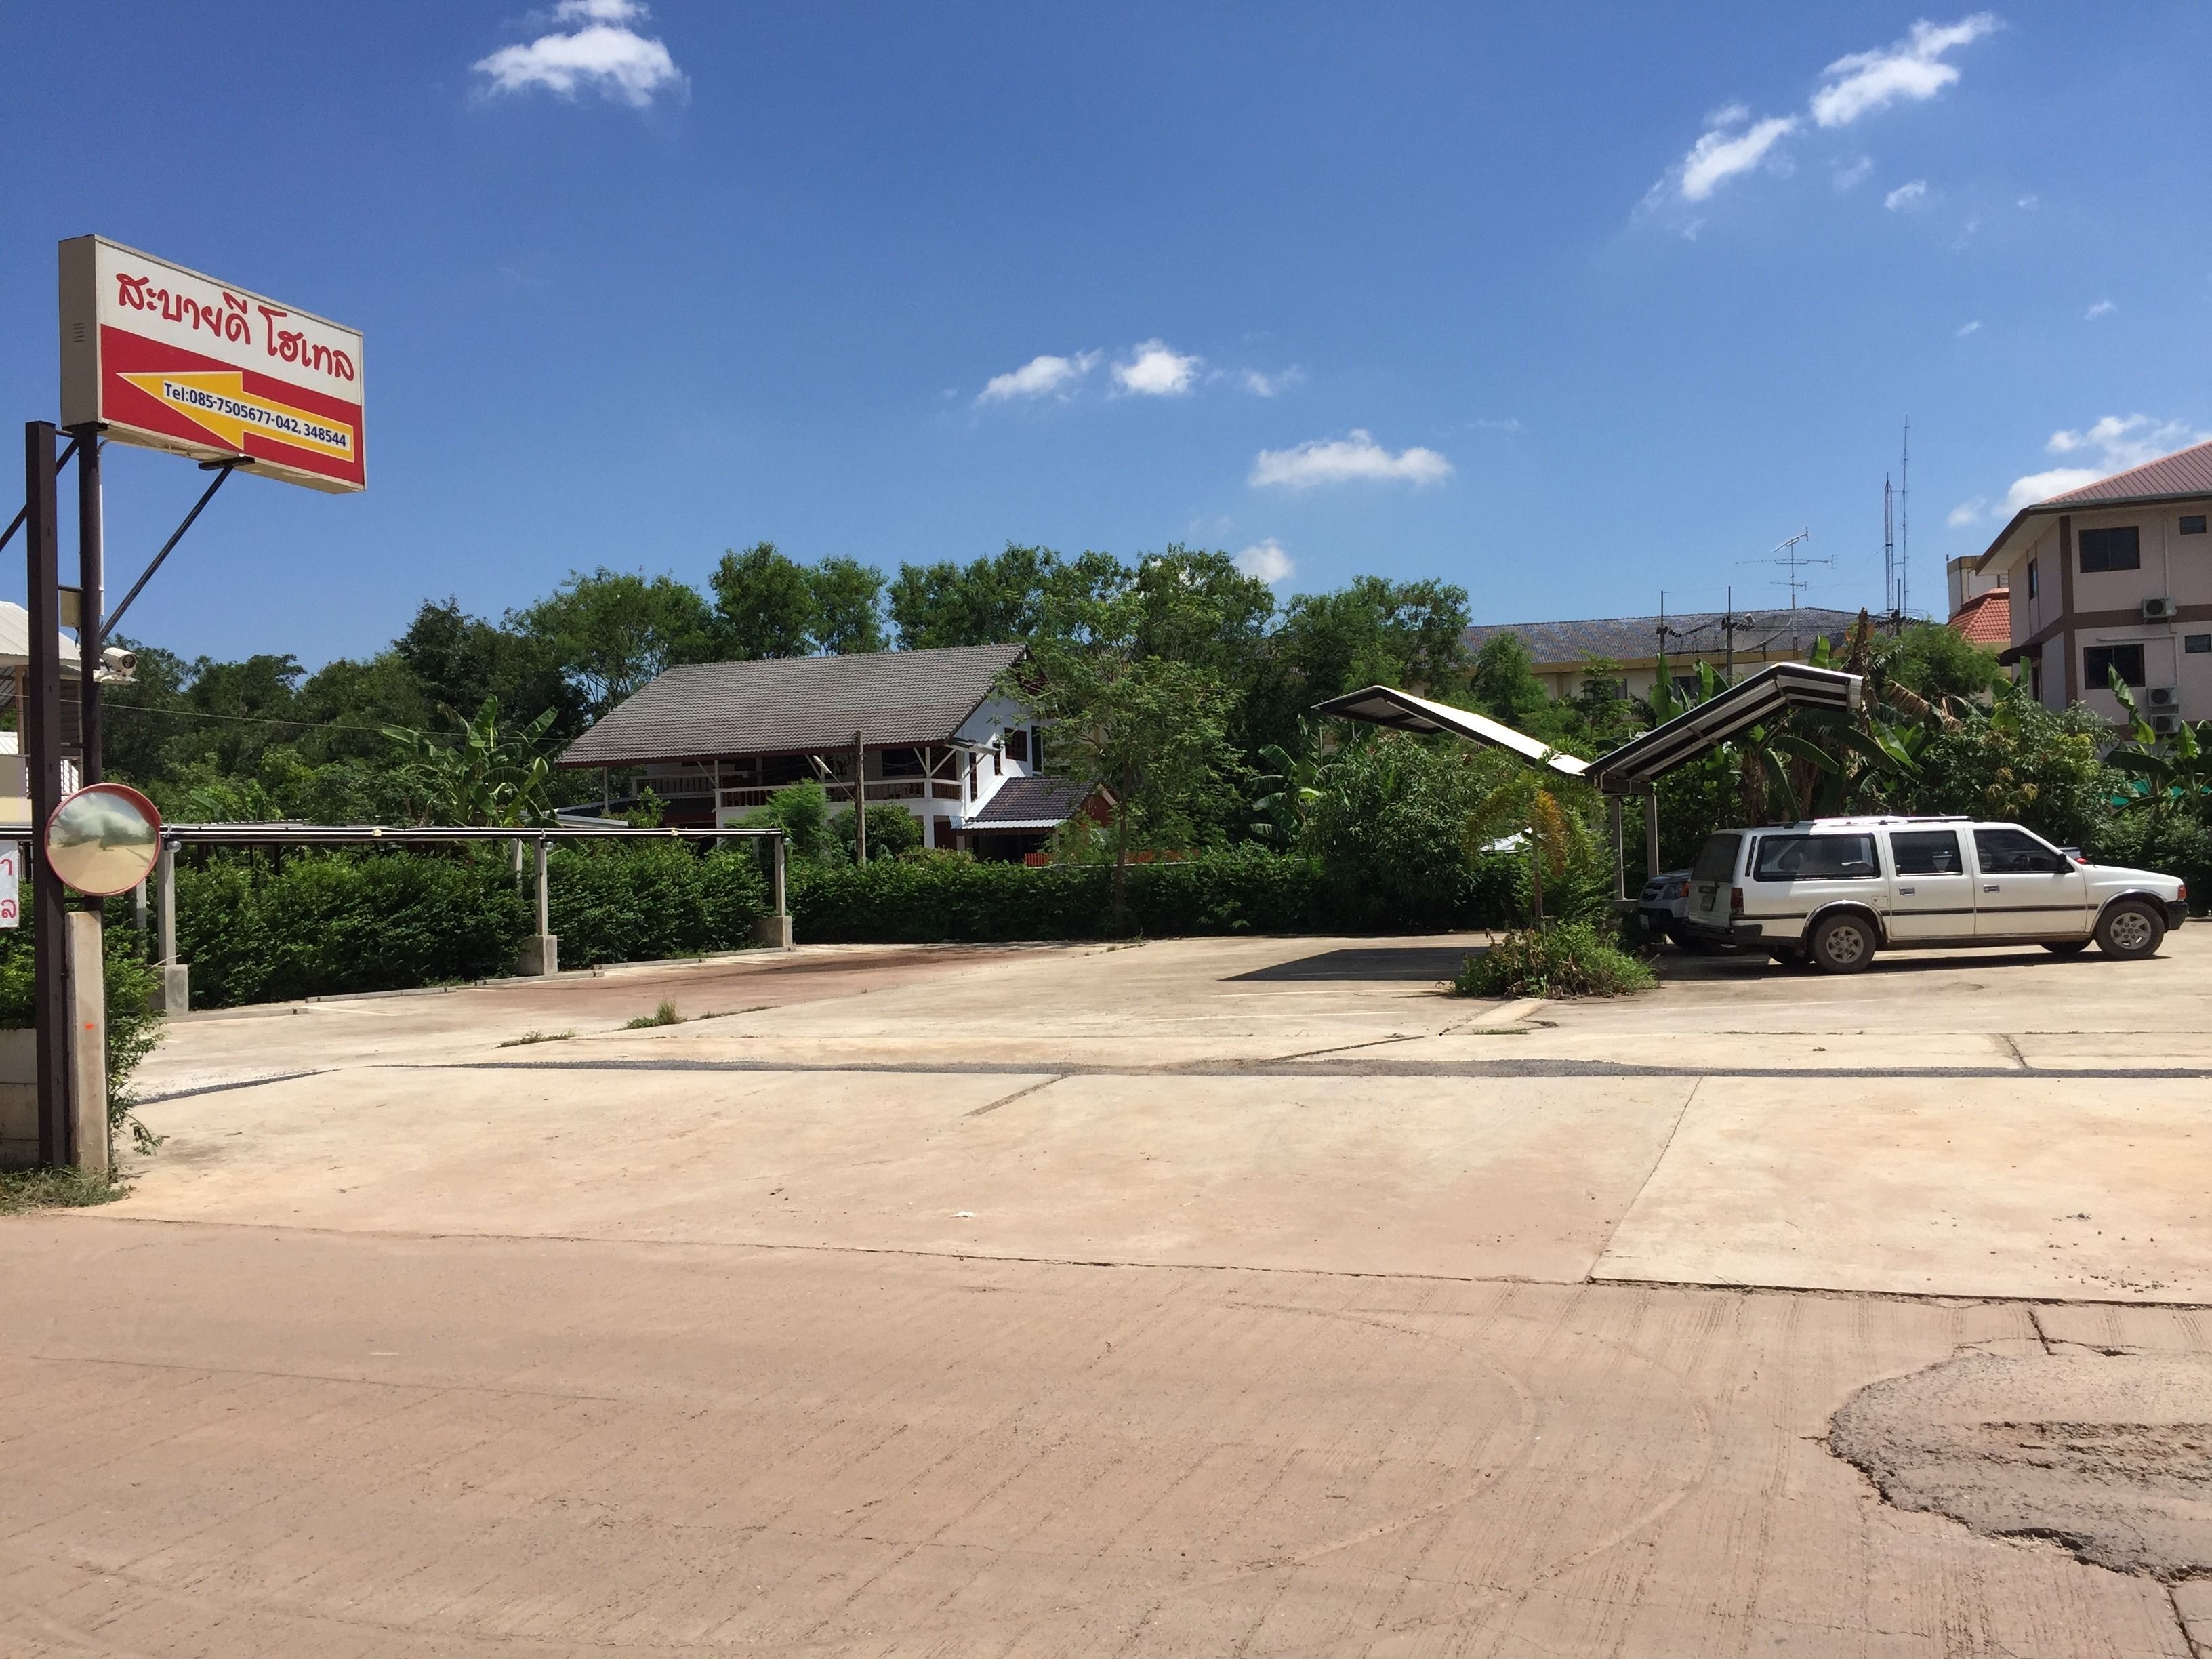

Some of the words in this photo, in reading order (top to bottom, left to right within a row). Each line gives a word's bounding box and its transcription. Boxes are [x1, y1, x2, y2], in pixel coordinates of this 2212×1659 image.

[116, 272, 251, 345] สะบายดี
[258, 304, 354, 382] โฮเทล
[304, 423, 347, 447] 348544
